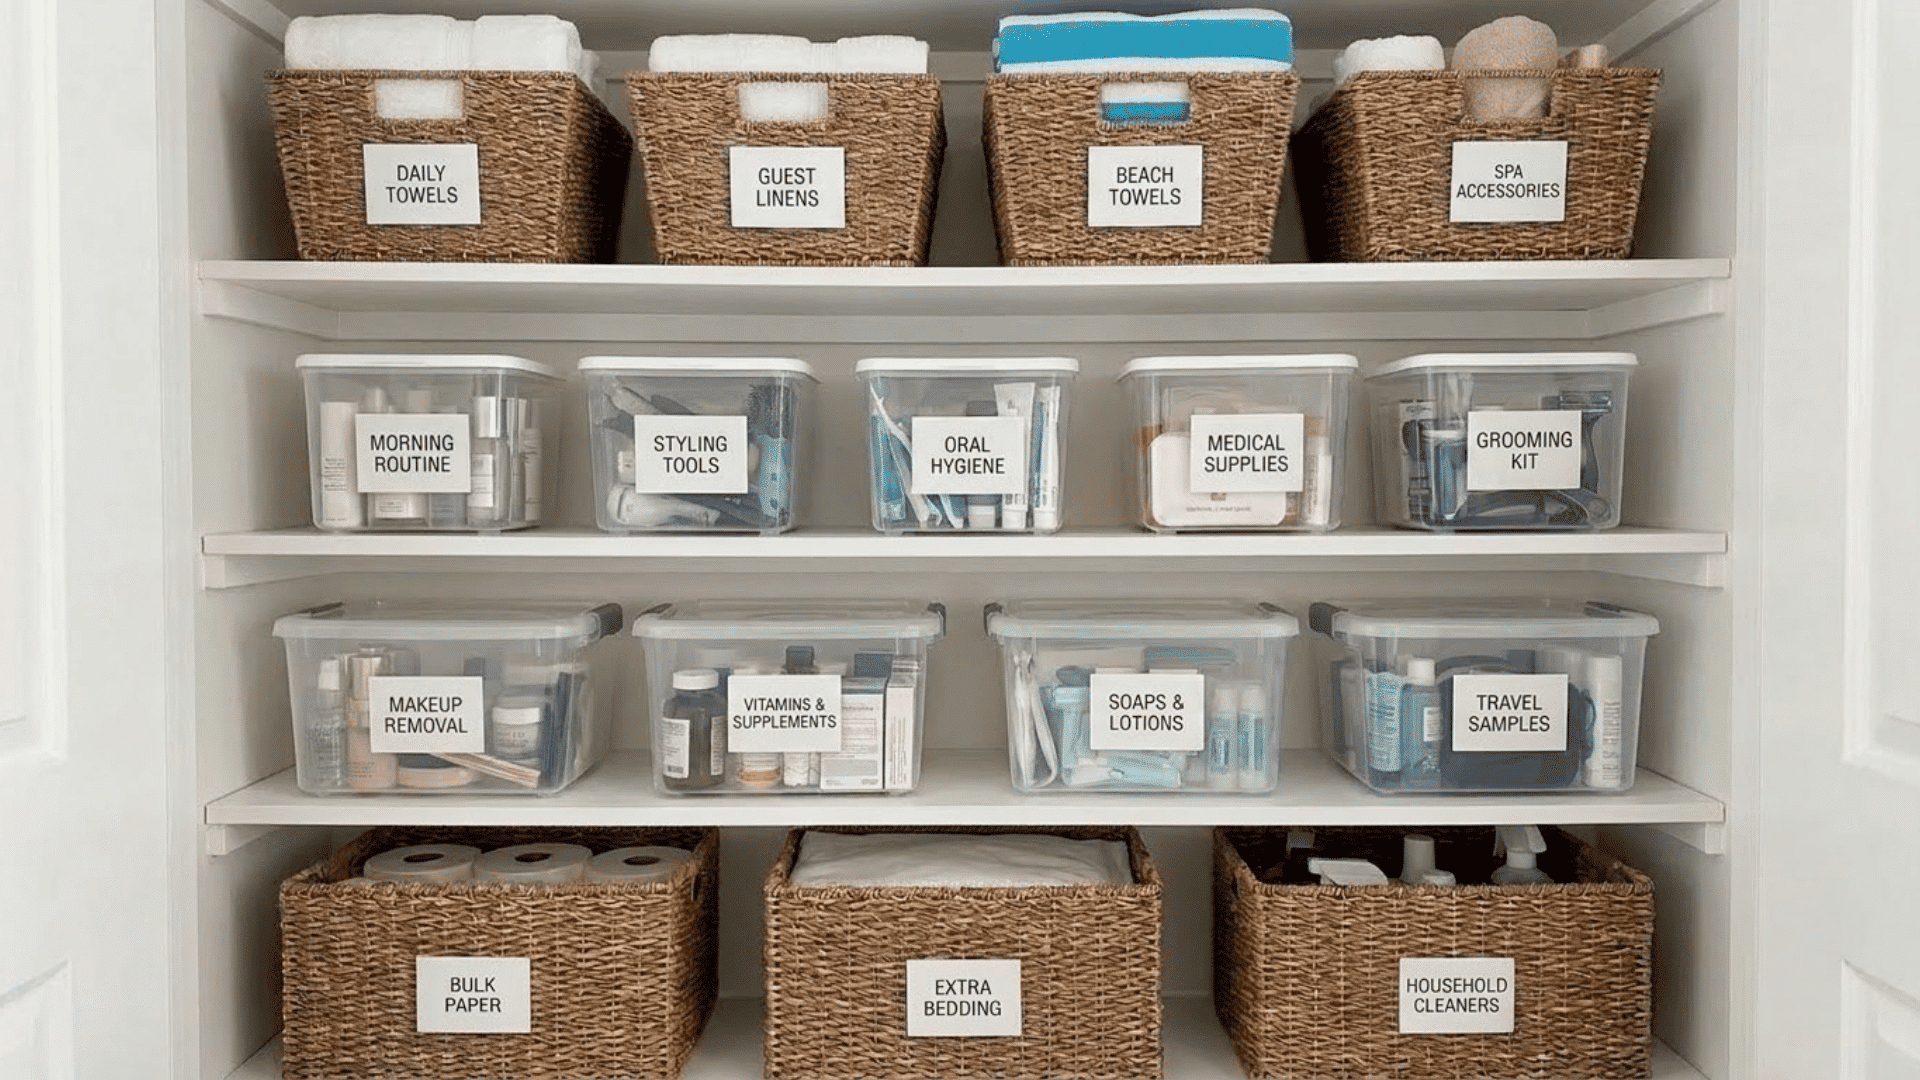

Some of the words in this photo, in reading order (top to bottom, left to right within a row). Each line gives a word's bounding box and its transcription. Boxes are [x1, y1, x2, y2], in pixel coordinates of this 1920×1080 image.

[396, 164, 446, 182] DAILY
[758, 167, 817, 185] GUEST
[1116, 165, 1174, 184] BEACH
[1494, 163, 1524, 180] SPA
[385, 186, 459, 204] TOWELS
[756, 189, 819, 208] LINENS
[1108, 187, 1182, 206] TOWELS
[1457, 182, 1560, 199] ACCESSORIES
[370, 433, 454, 452] MORNING
[653, 435, 728, 453] STYLING
[944, 435, 991, 454] ORAL
[1208, 434, 1286, 452] MEDICAL
[1476, 430, 1573, 449] GROOMING
[374, 455, 451, 473] ROUTINE
[662, 456, 720, 474] TOOLS
[931, 457, 1005, 475] HYGIENE
[1204, 455, 1289, 473] SUPPLIES
[1511, 452, 1539, 470] KIT
[389, 696, 463, 713] MAKEUP
[743, 697, 812, 712] VITAMINS
[814, 697, 826, 712] &
[1108, 693, 1167, 711] SOAPS
[1172, 693, 1185, 711] &
[1476, 694, 1543, 711] TRAVEL
[384, 716, 468, 734] REMOVAL
[733, 714, 837, 730] SUPPLEMENTS
[1109, 714, 1184, 732] LOTIONS
[1468, 714, 1551, 733] SAMPLES
[450, 976, 496, 993] BULK
[935, 978, 992, 996] EXTRA
[1406, 977, 1508, 994] HOUSEHOLD
[444, 997, 502, 1013] PAPER
[924, 1000, 1002, 1017] BEDDING
[1413, 997, 1500, 1014] CLEANERS
